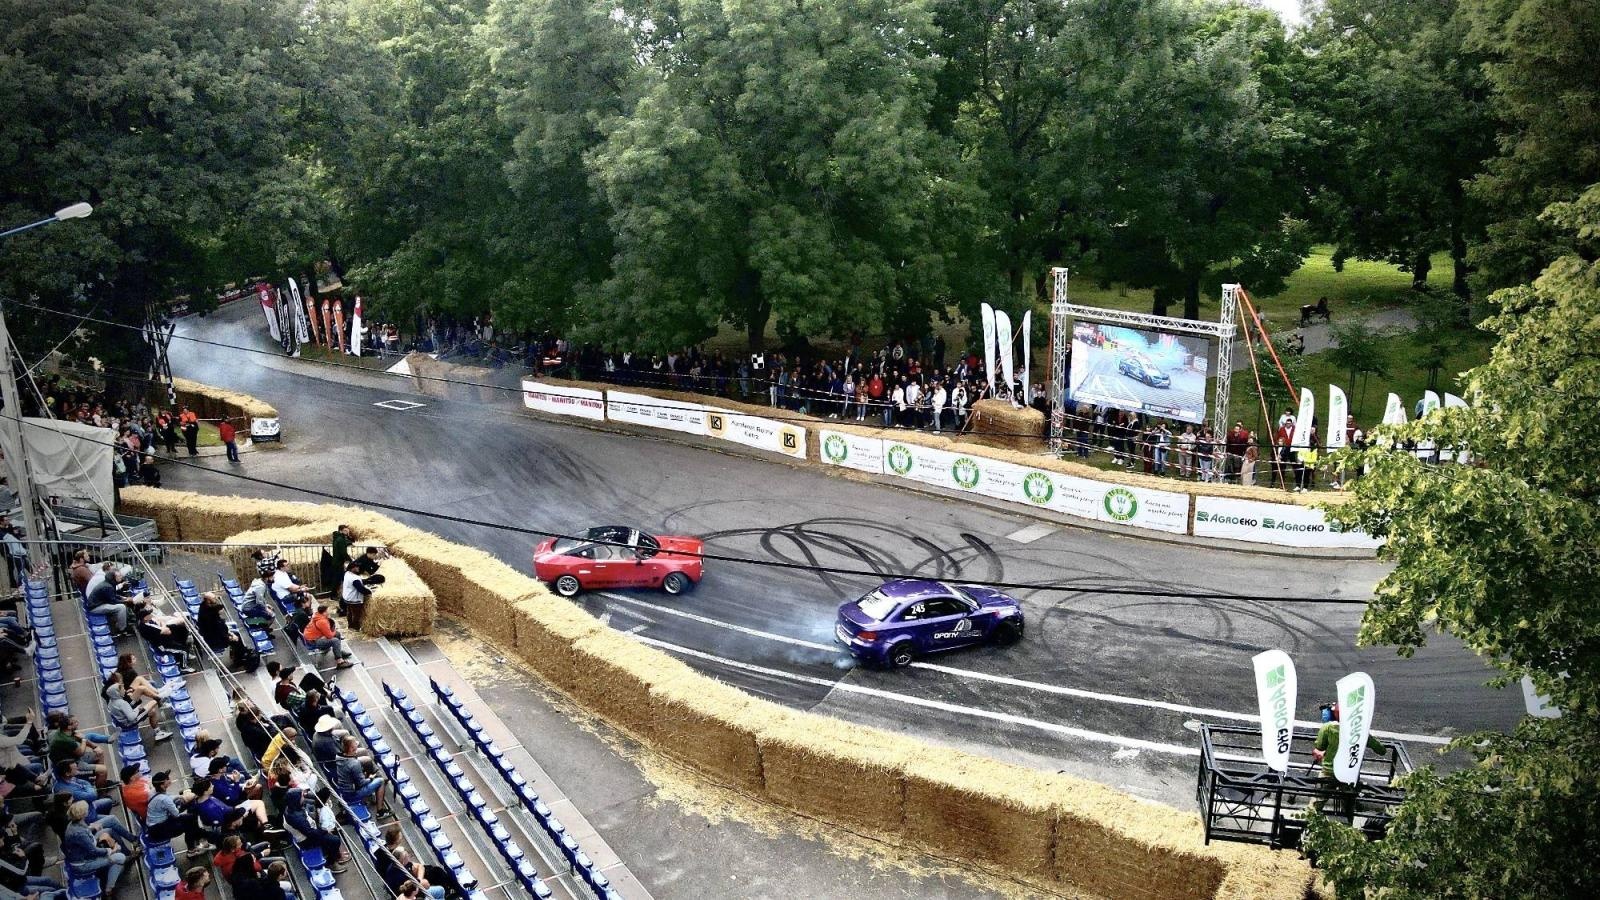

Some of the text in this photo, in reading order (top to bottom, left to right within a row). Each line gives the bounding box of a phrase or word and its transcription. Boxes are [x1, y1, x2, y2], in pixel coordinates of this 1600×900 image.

[1210, 513, 1258, 527] AGROEKO
[1276, 520, 1325, 532] AGROEKO
[911, 604, 926, 614] 245
